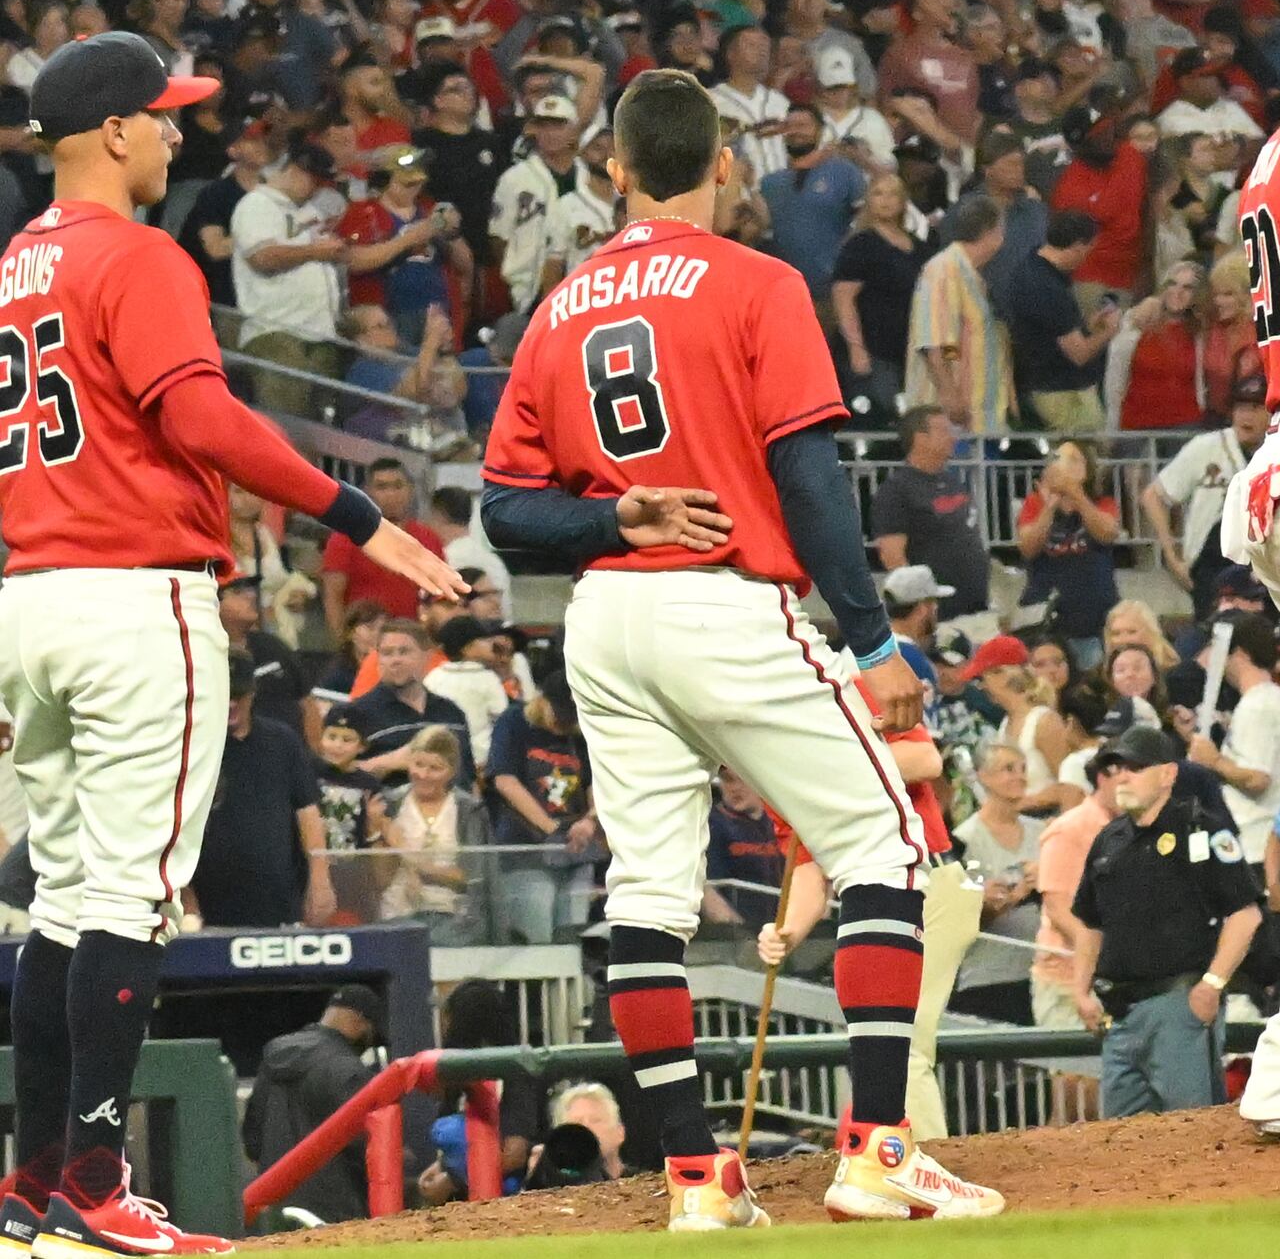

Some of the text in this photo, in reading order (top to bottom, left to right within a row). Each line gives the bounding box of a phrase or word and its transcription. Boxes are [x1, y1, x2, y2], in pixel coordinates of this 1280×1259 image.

[549, 254, 710, 330] ROSARIO
[0, 312, 85, 476] 25
[581, 314, 672, 463] 8
[230, 934, 353, 969] GEICO
